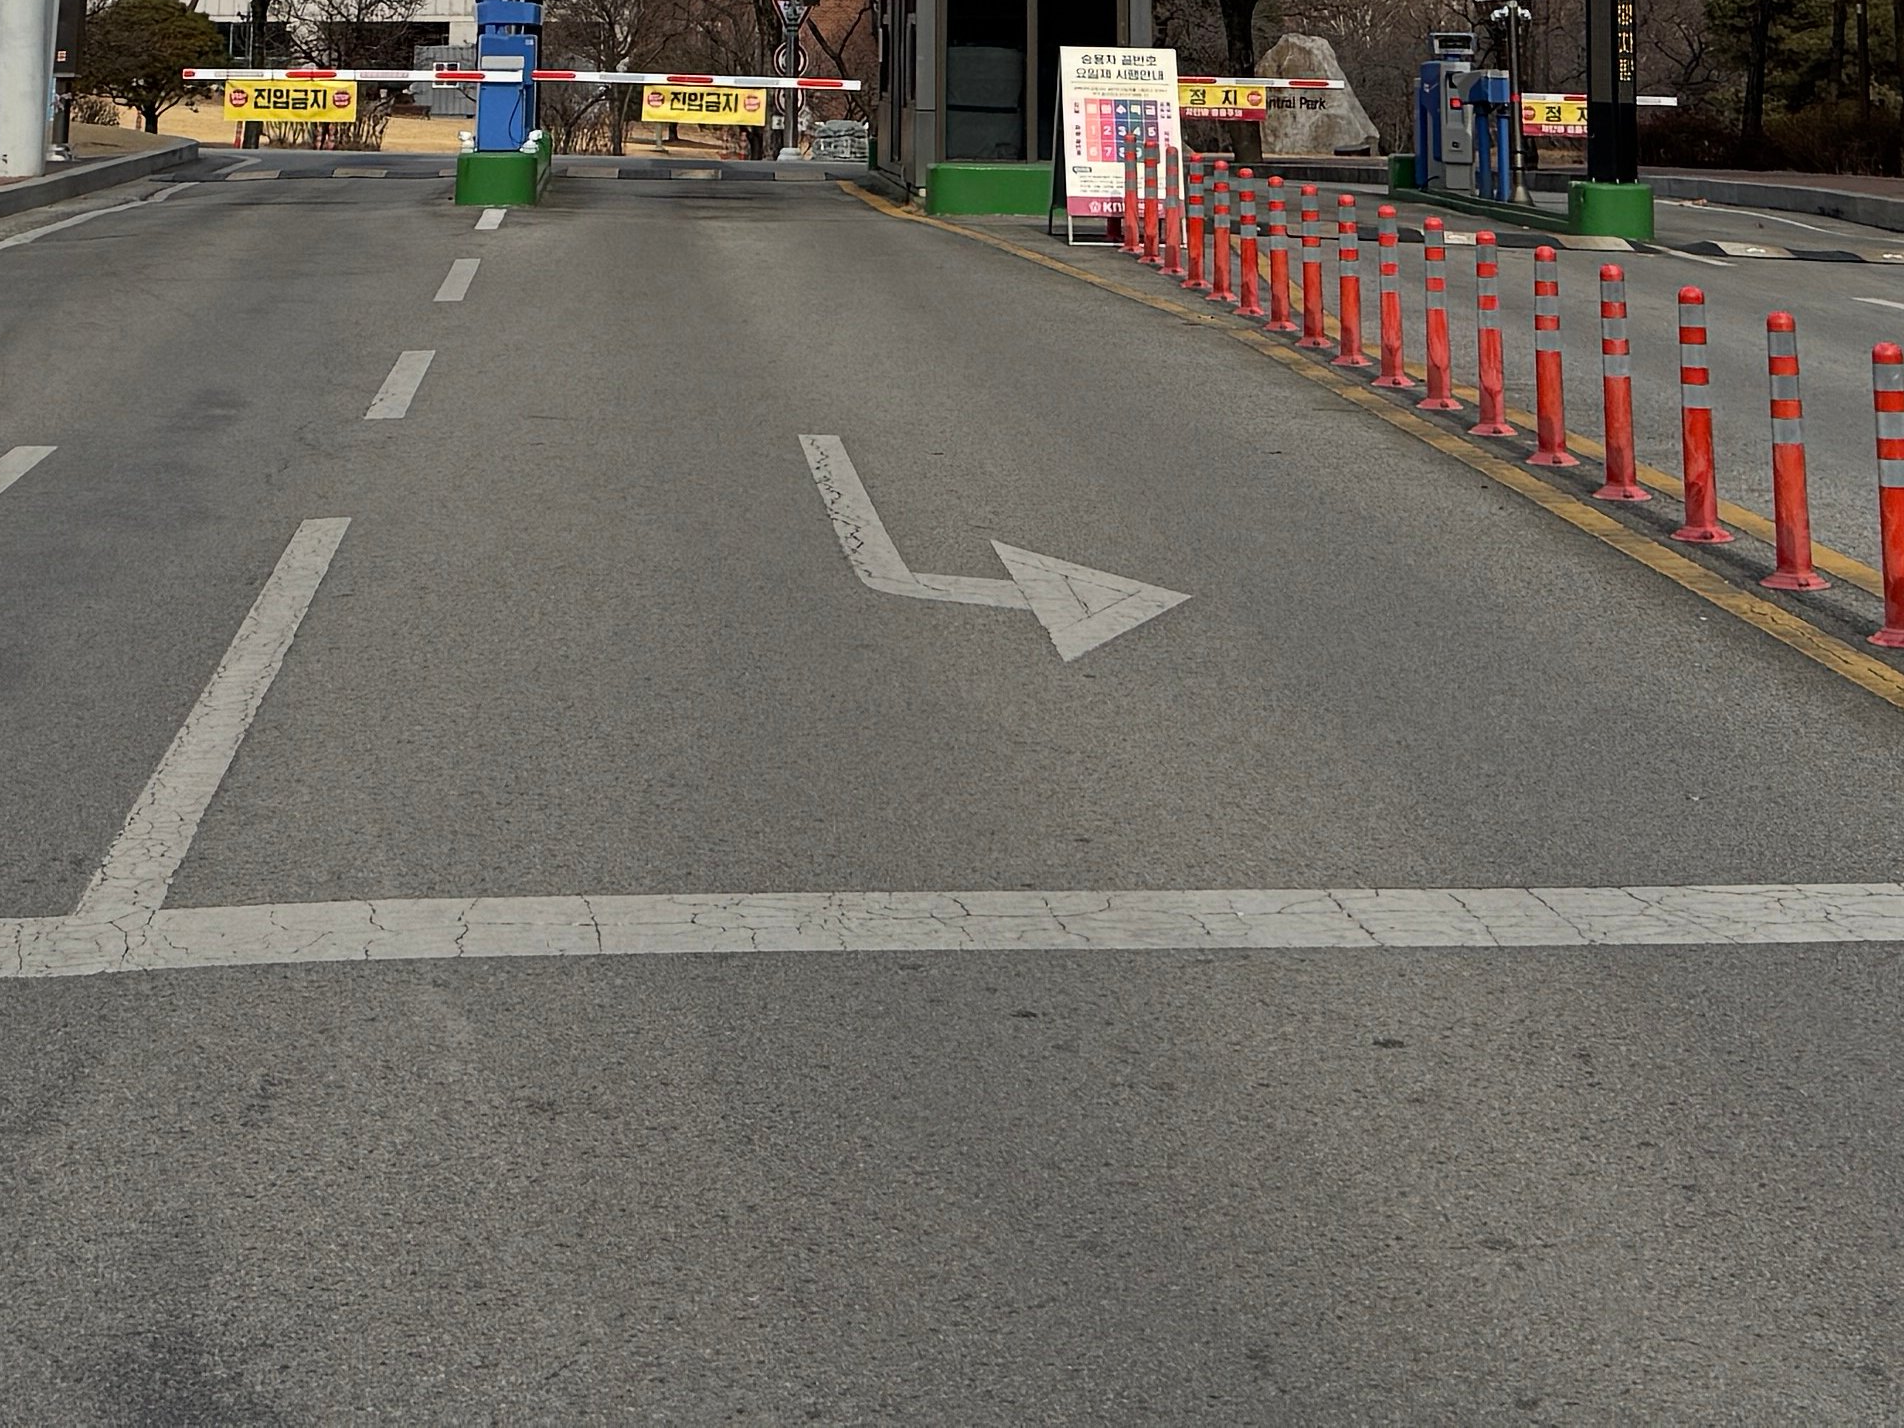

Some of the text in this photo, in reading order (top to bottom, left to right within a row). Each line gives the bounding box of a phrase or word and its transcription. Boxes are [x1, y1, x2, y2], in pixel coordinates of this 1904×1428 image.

[253, 88, 327, 110] 진입금지
[670, 91, 739, 113] 진입금지
[1267, 96, 1296, 110] ntral
[1300, 97, 1326, 110] Park
[1103, 125, 1112, 136] 2
[1118, 126, 1127, 136] 3
[1104, 147, 1113, 157] 7
